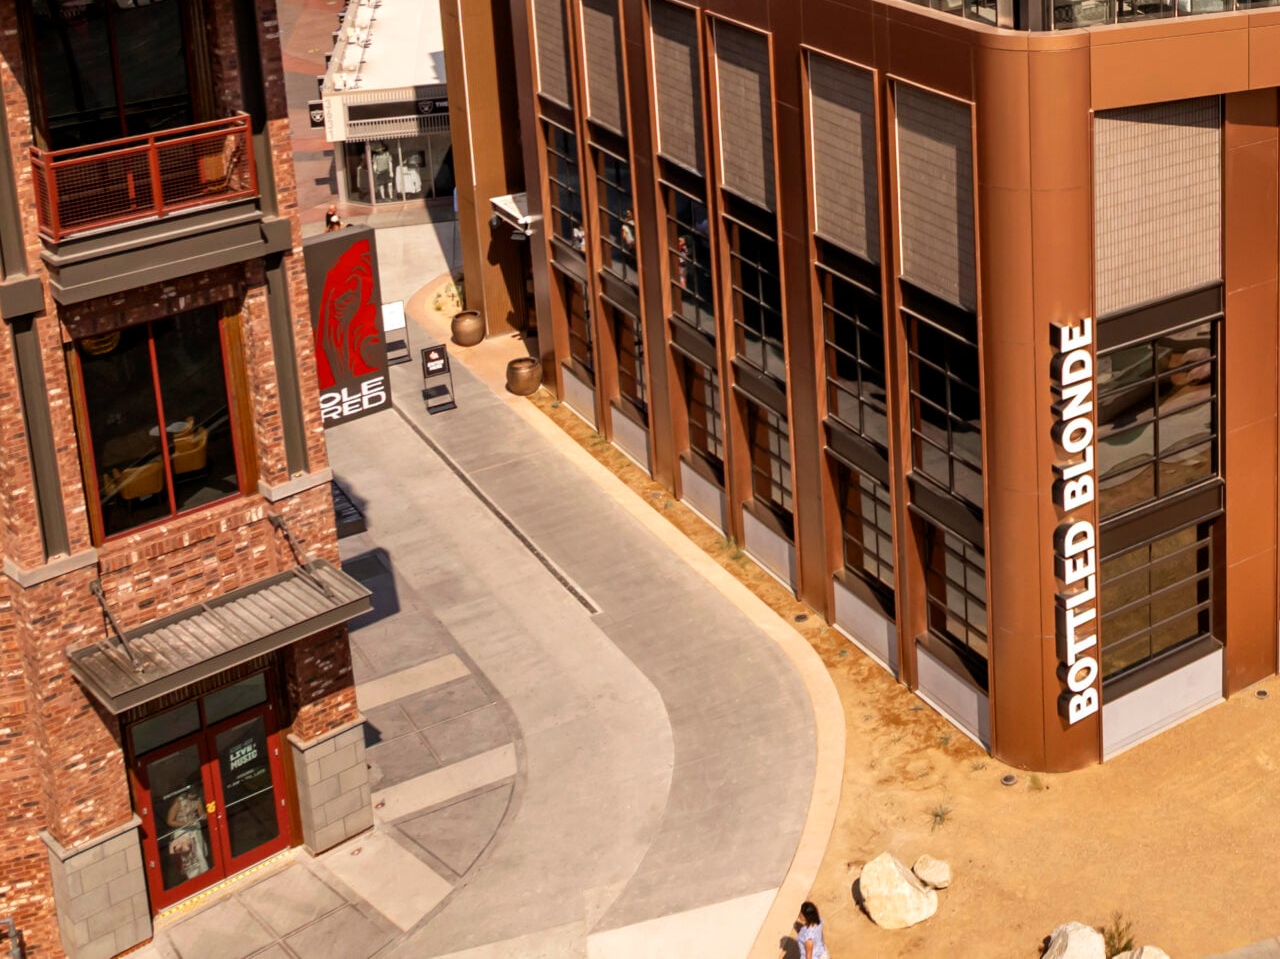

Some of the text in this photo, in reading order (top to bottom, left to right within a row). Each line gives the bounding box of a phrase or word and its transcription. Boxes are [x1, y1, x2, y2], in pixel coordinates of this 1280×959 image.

[320, 375, 385, 409] OLE
[320, 390, 387, 424] RED
[1058, 316, 1099, 725] BOTTLED BLONDE
[230, 744, 253, 762] LIVE
[230, 749, 257, 771] MUSIC
